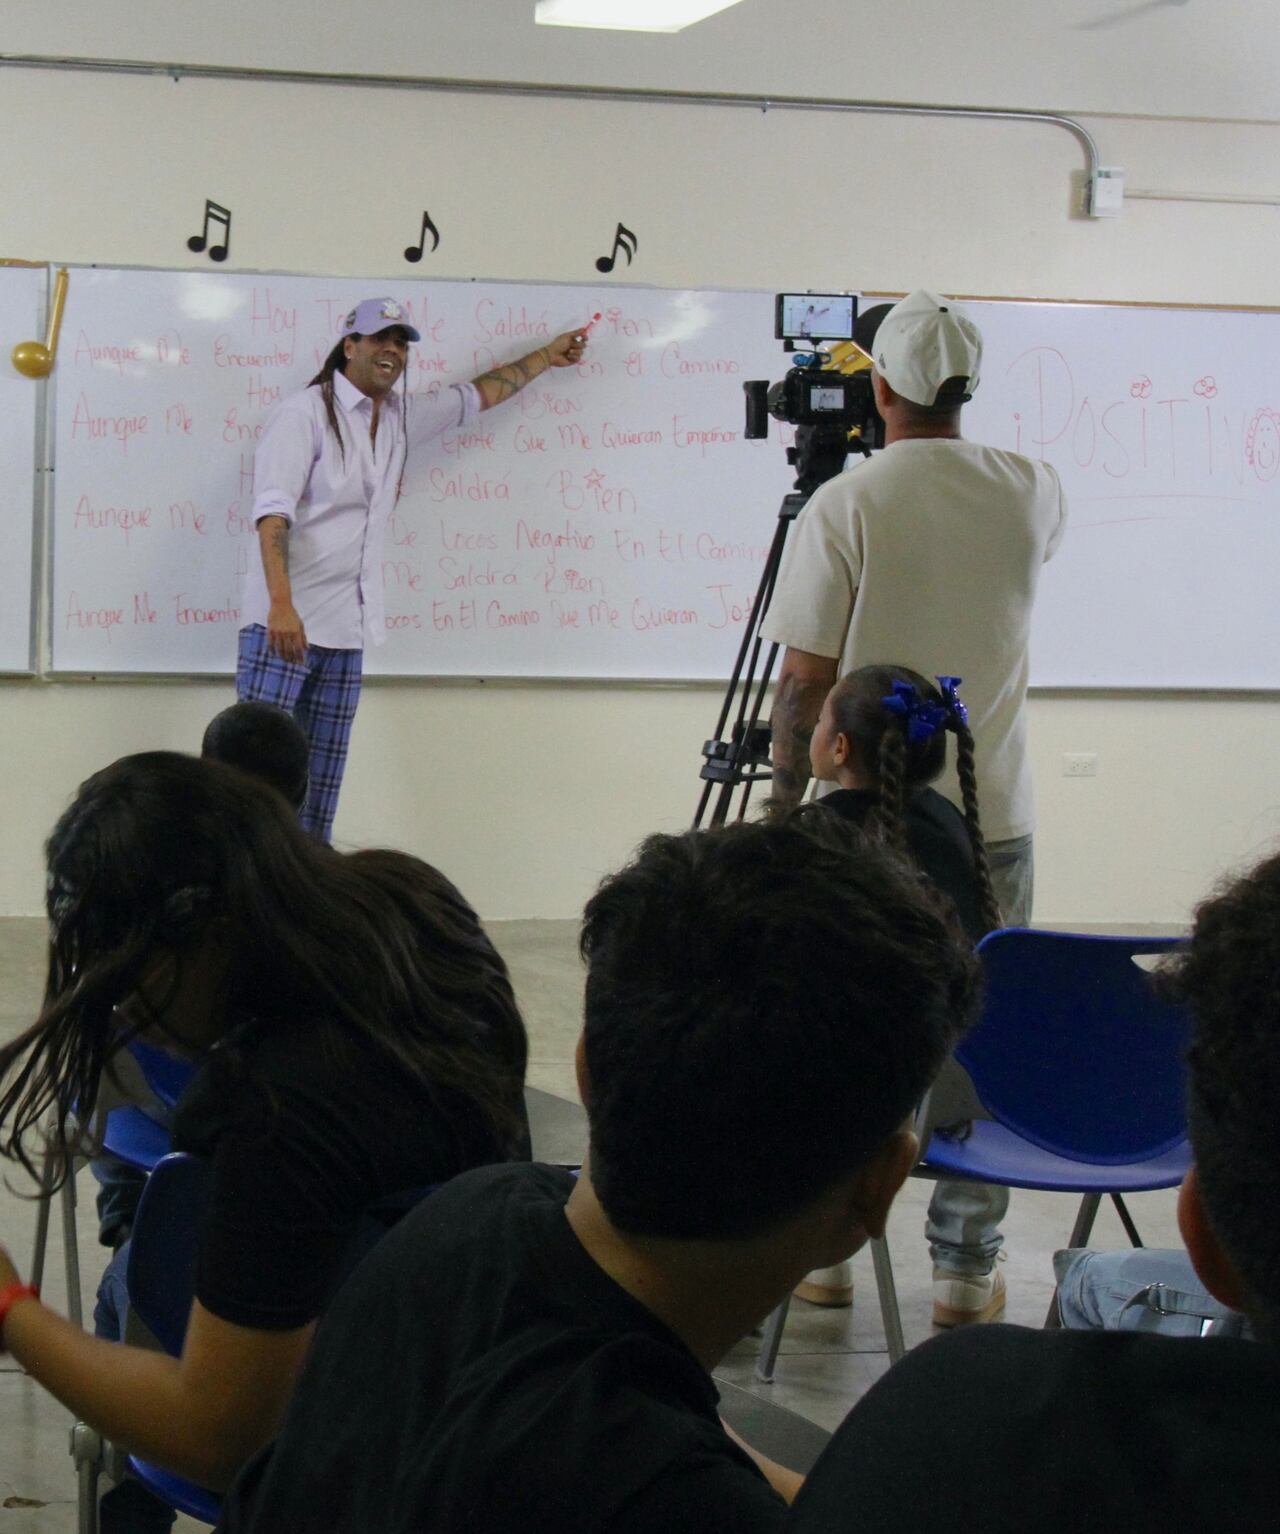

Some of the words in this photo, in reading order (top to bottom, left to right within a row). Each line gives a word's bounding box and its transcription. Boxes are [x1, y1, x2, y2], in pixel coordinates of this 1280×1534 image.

[251, 287, 297, 366] Hoy
[473, 298, 550, 344] Saldrá
[73, 328, 145, 376] Aunque
[659, 341, 740, 379] Camino
[71, 390, 148, 457] Aunque
[166, 403, 193, 436] Me
[514, 424, 548, 453] Que
[557, 422, 593, 451] Me
[430, 466, 512, 502] Saldrá
[548, 468, 637, 514] Bien
[74, 496, 152, 546] Aunque
[169, 501, 208, 536] Me
[517, 519, 596, 565] Negativo
[613, 529, 645, 562] En
[381, 560, 423, 592] Me
[438, 556, 521, 591] Saldrá
[541, 565, 605, 594] Bien
[385, 614, 422, 630] ocos
[431, 600, 454, 631] En
[486, 600, 541, 630] Camino
[588, 599, 620, 630] Me
